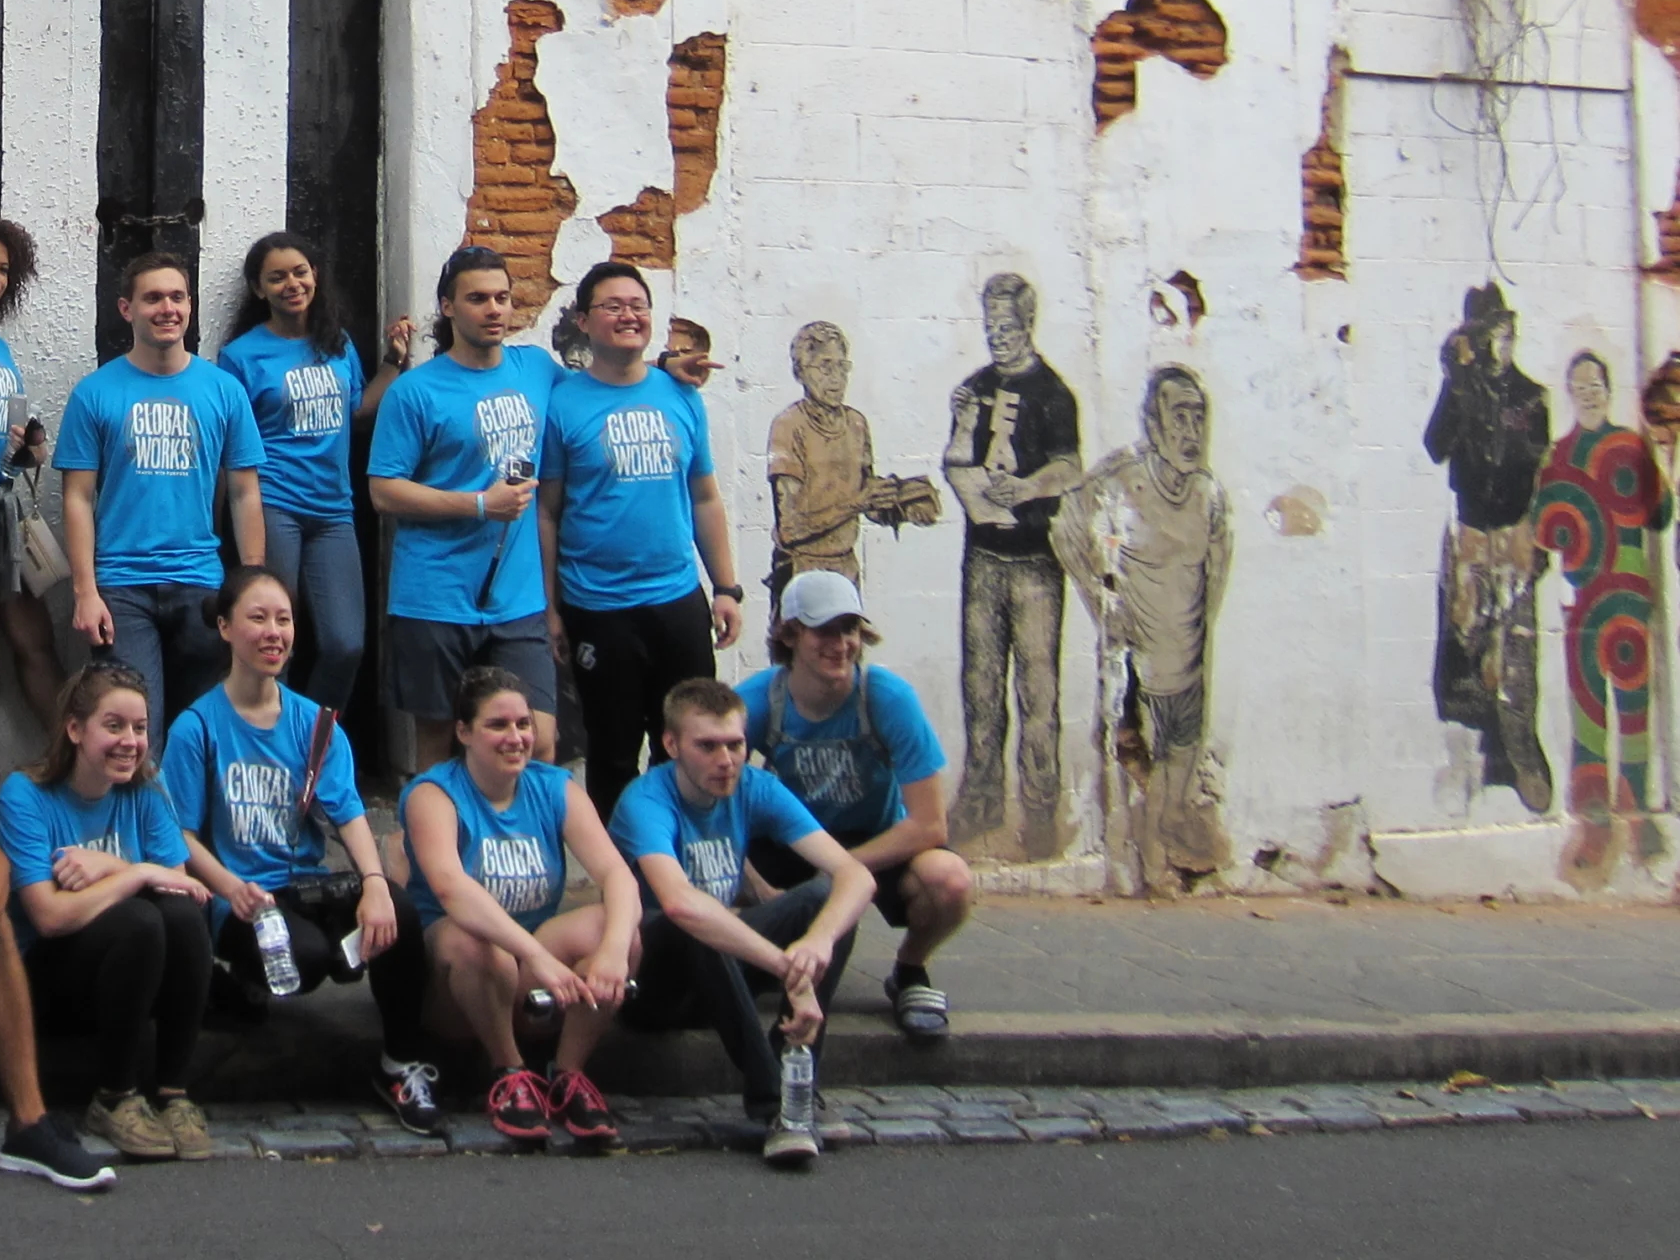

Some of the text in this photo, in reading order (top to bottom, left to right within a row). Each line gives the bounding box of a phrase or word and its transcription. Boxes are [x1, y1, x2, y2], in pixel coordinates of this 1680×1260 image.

[285, 364, 342, 401] GLOBAL
[132, 402, 192, 436] GLOBAL
[293, 396, 344, 433] WORKS
[476, 393, 535, 433] GLOBAL
[606, 410, 671, 445] GLOBAL
[135, 435, 191, 471] WORKS
[612, 441, 673, 477] WORKS
[794, 746, 860, 778] GLOBAL
[227, 762, 291, 807] GLOBAL
[230, 803, 290, 846] WORKS
[482, 836, 547, 877] GLOBAL
